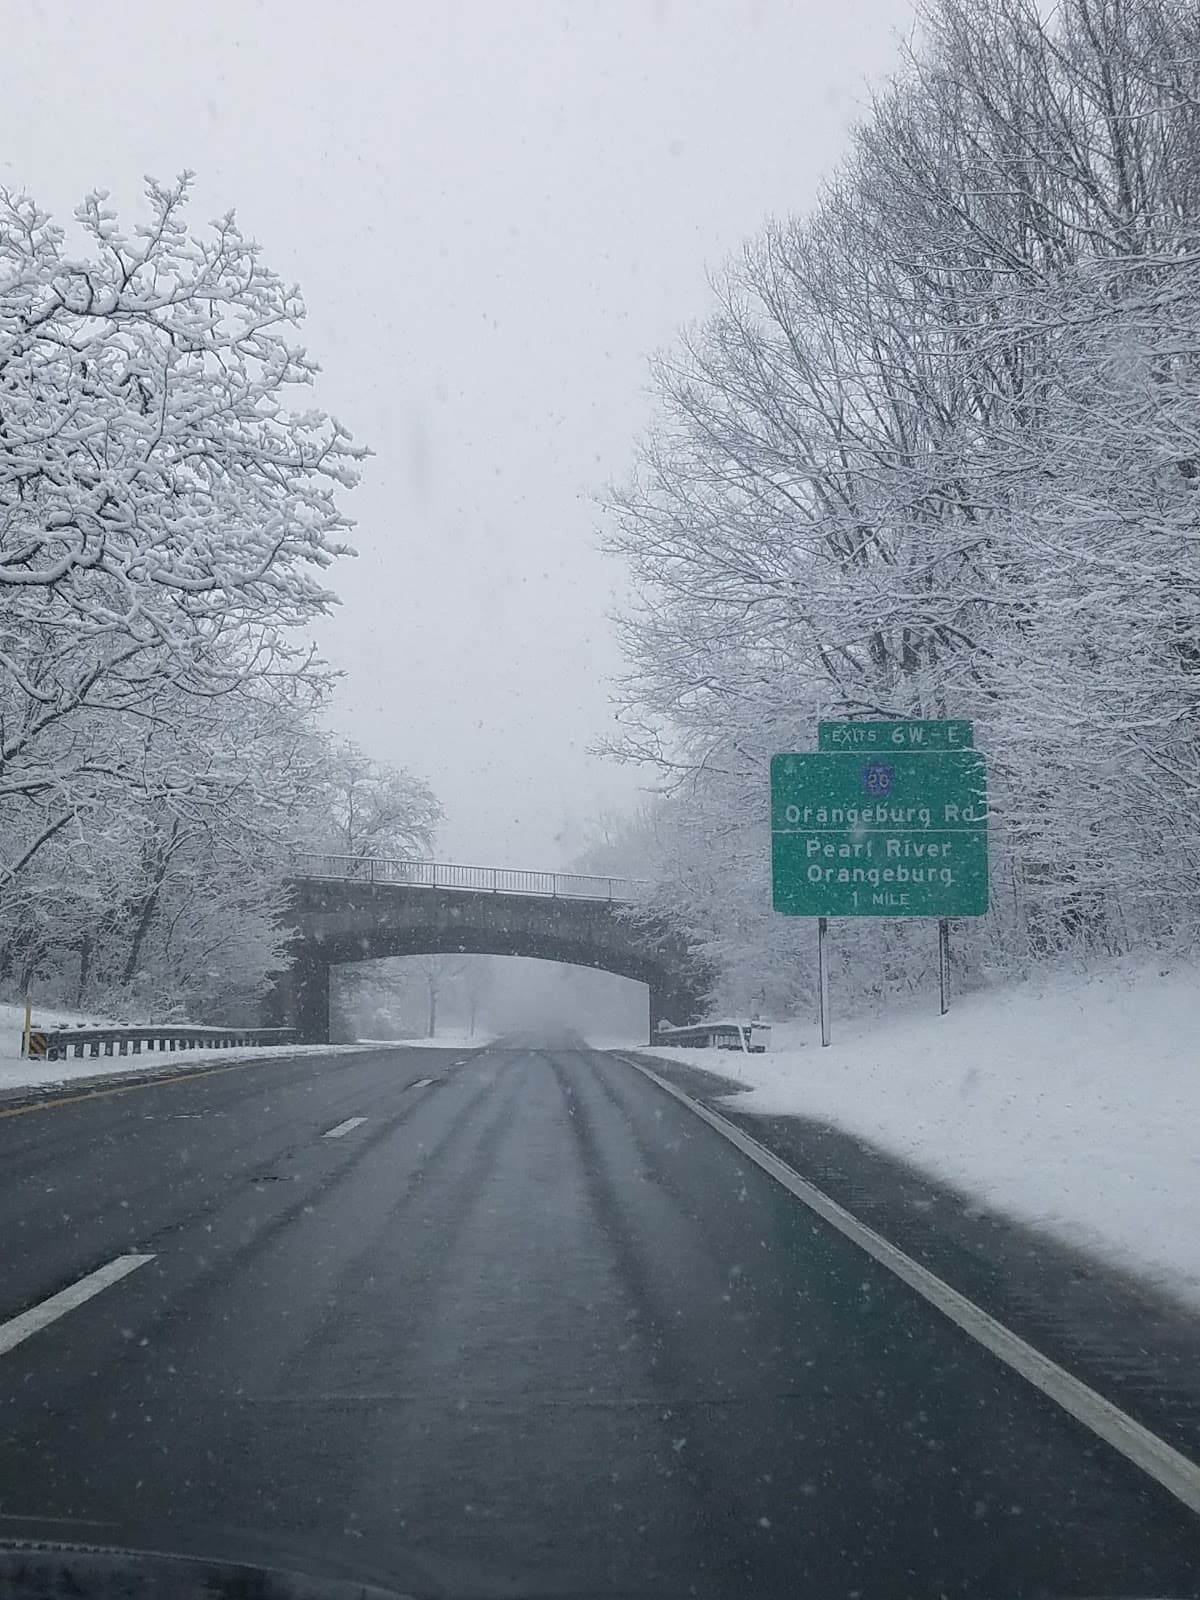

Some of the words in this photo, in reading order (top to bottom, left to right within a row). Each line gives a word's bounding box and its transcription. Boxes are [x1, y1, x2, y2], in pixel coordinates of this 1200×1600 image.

[832, 730, 876, 743] EXITS
[868, 774, 890, 788] 20
[785, 804, 931, 828] Orangeburg
[944, 804, 975, 822] Rd
[806, 839, 873, 858] Pearl
[886, 839, 952, 858] River
[806, 864, 953, 888] Orangeburg
[851, 891, 858, 907] 1
[872, 893, 910, 905] MILE
